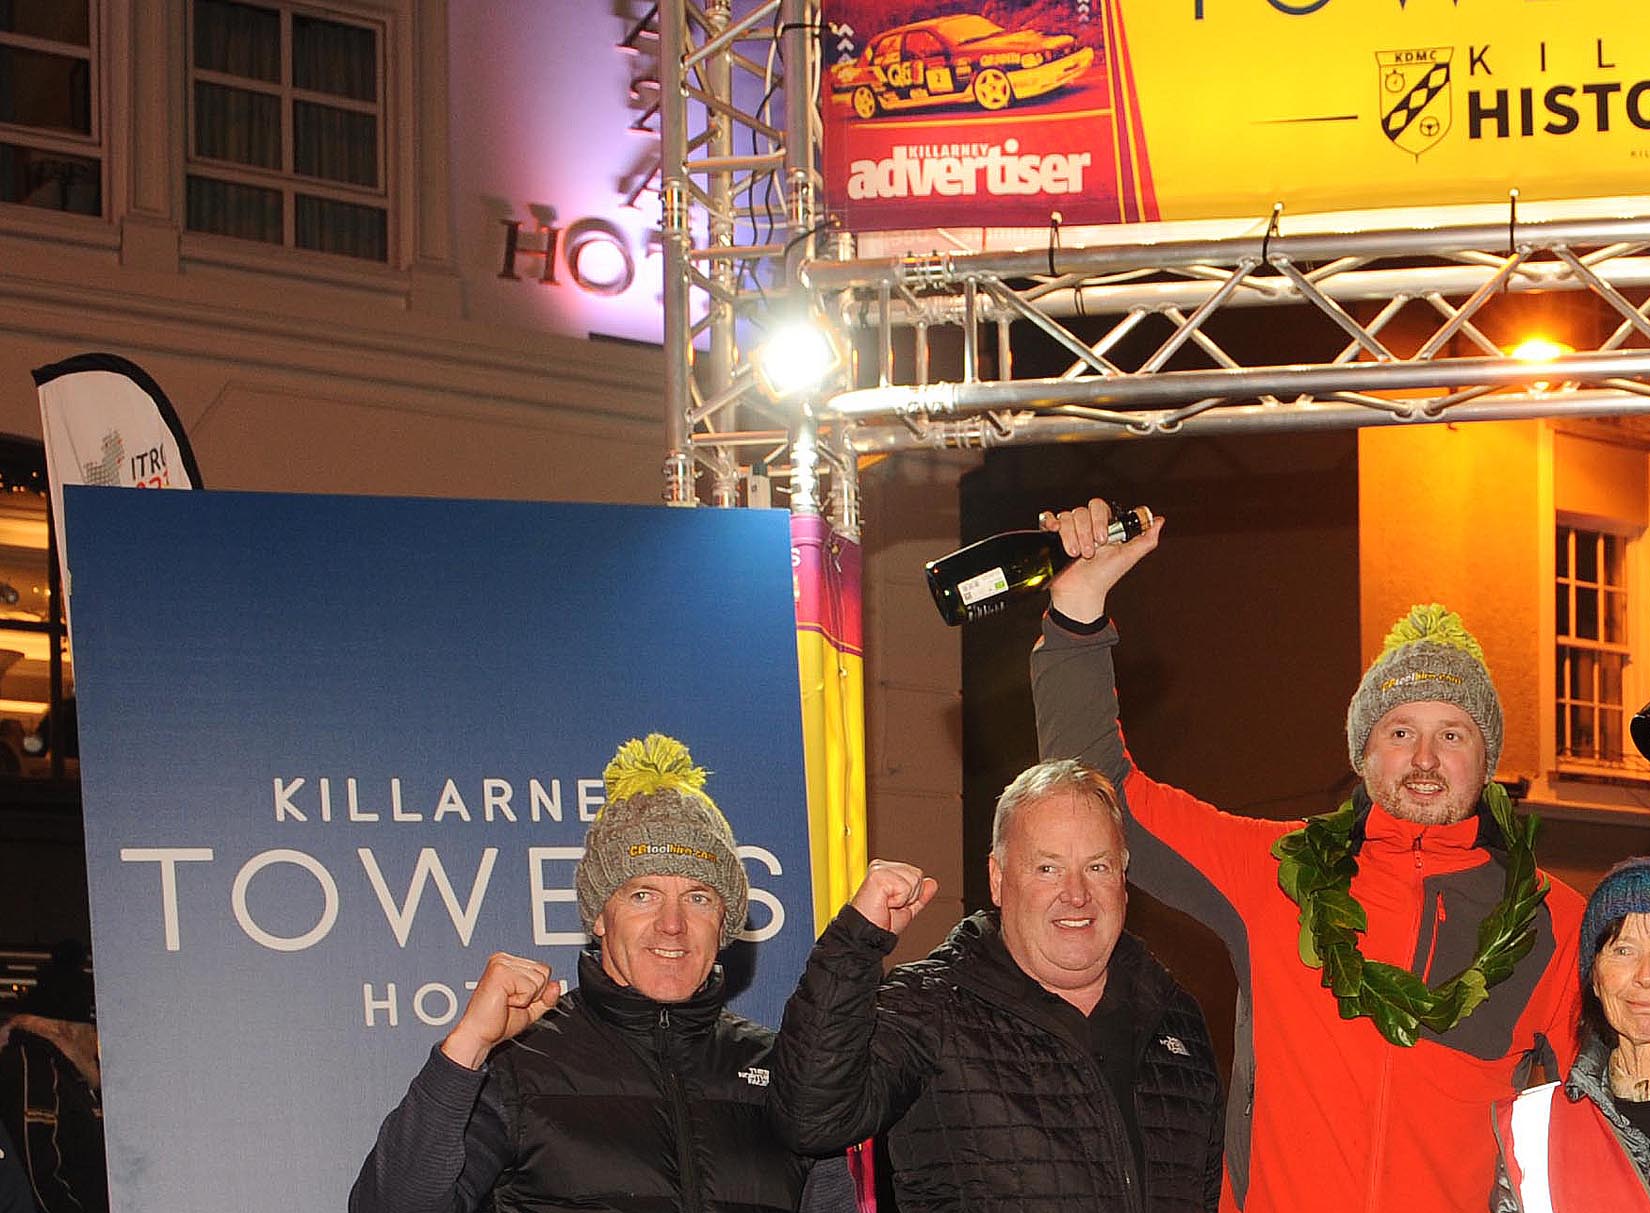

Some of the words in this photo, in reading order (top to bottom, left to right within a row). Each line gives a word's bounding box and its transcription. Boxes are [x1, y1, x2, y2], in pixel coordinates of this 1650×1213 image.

[1395, 49, 1437, 63] KDMC
[847, 138, 1092, 200] advertiser
[908, 143, 989, 159] KILLARNEY
[273, 777, 605, 823] KILLARNE
[120, 845, 785, 952] TOWES
